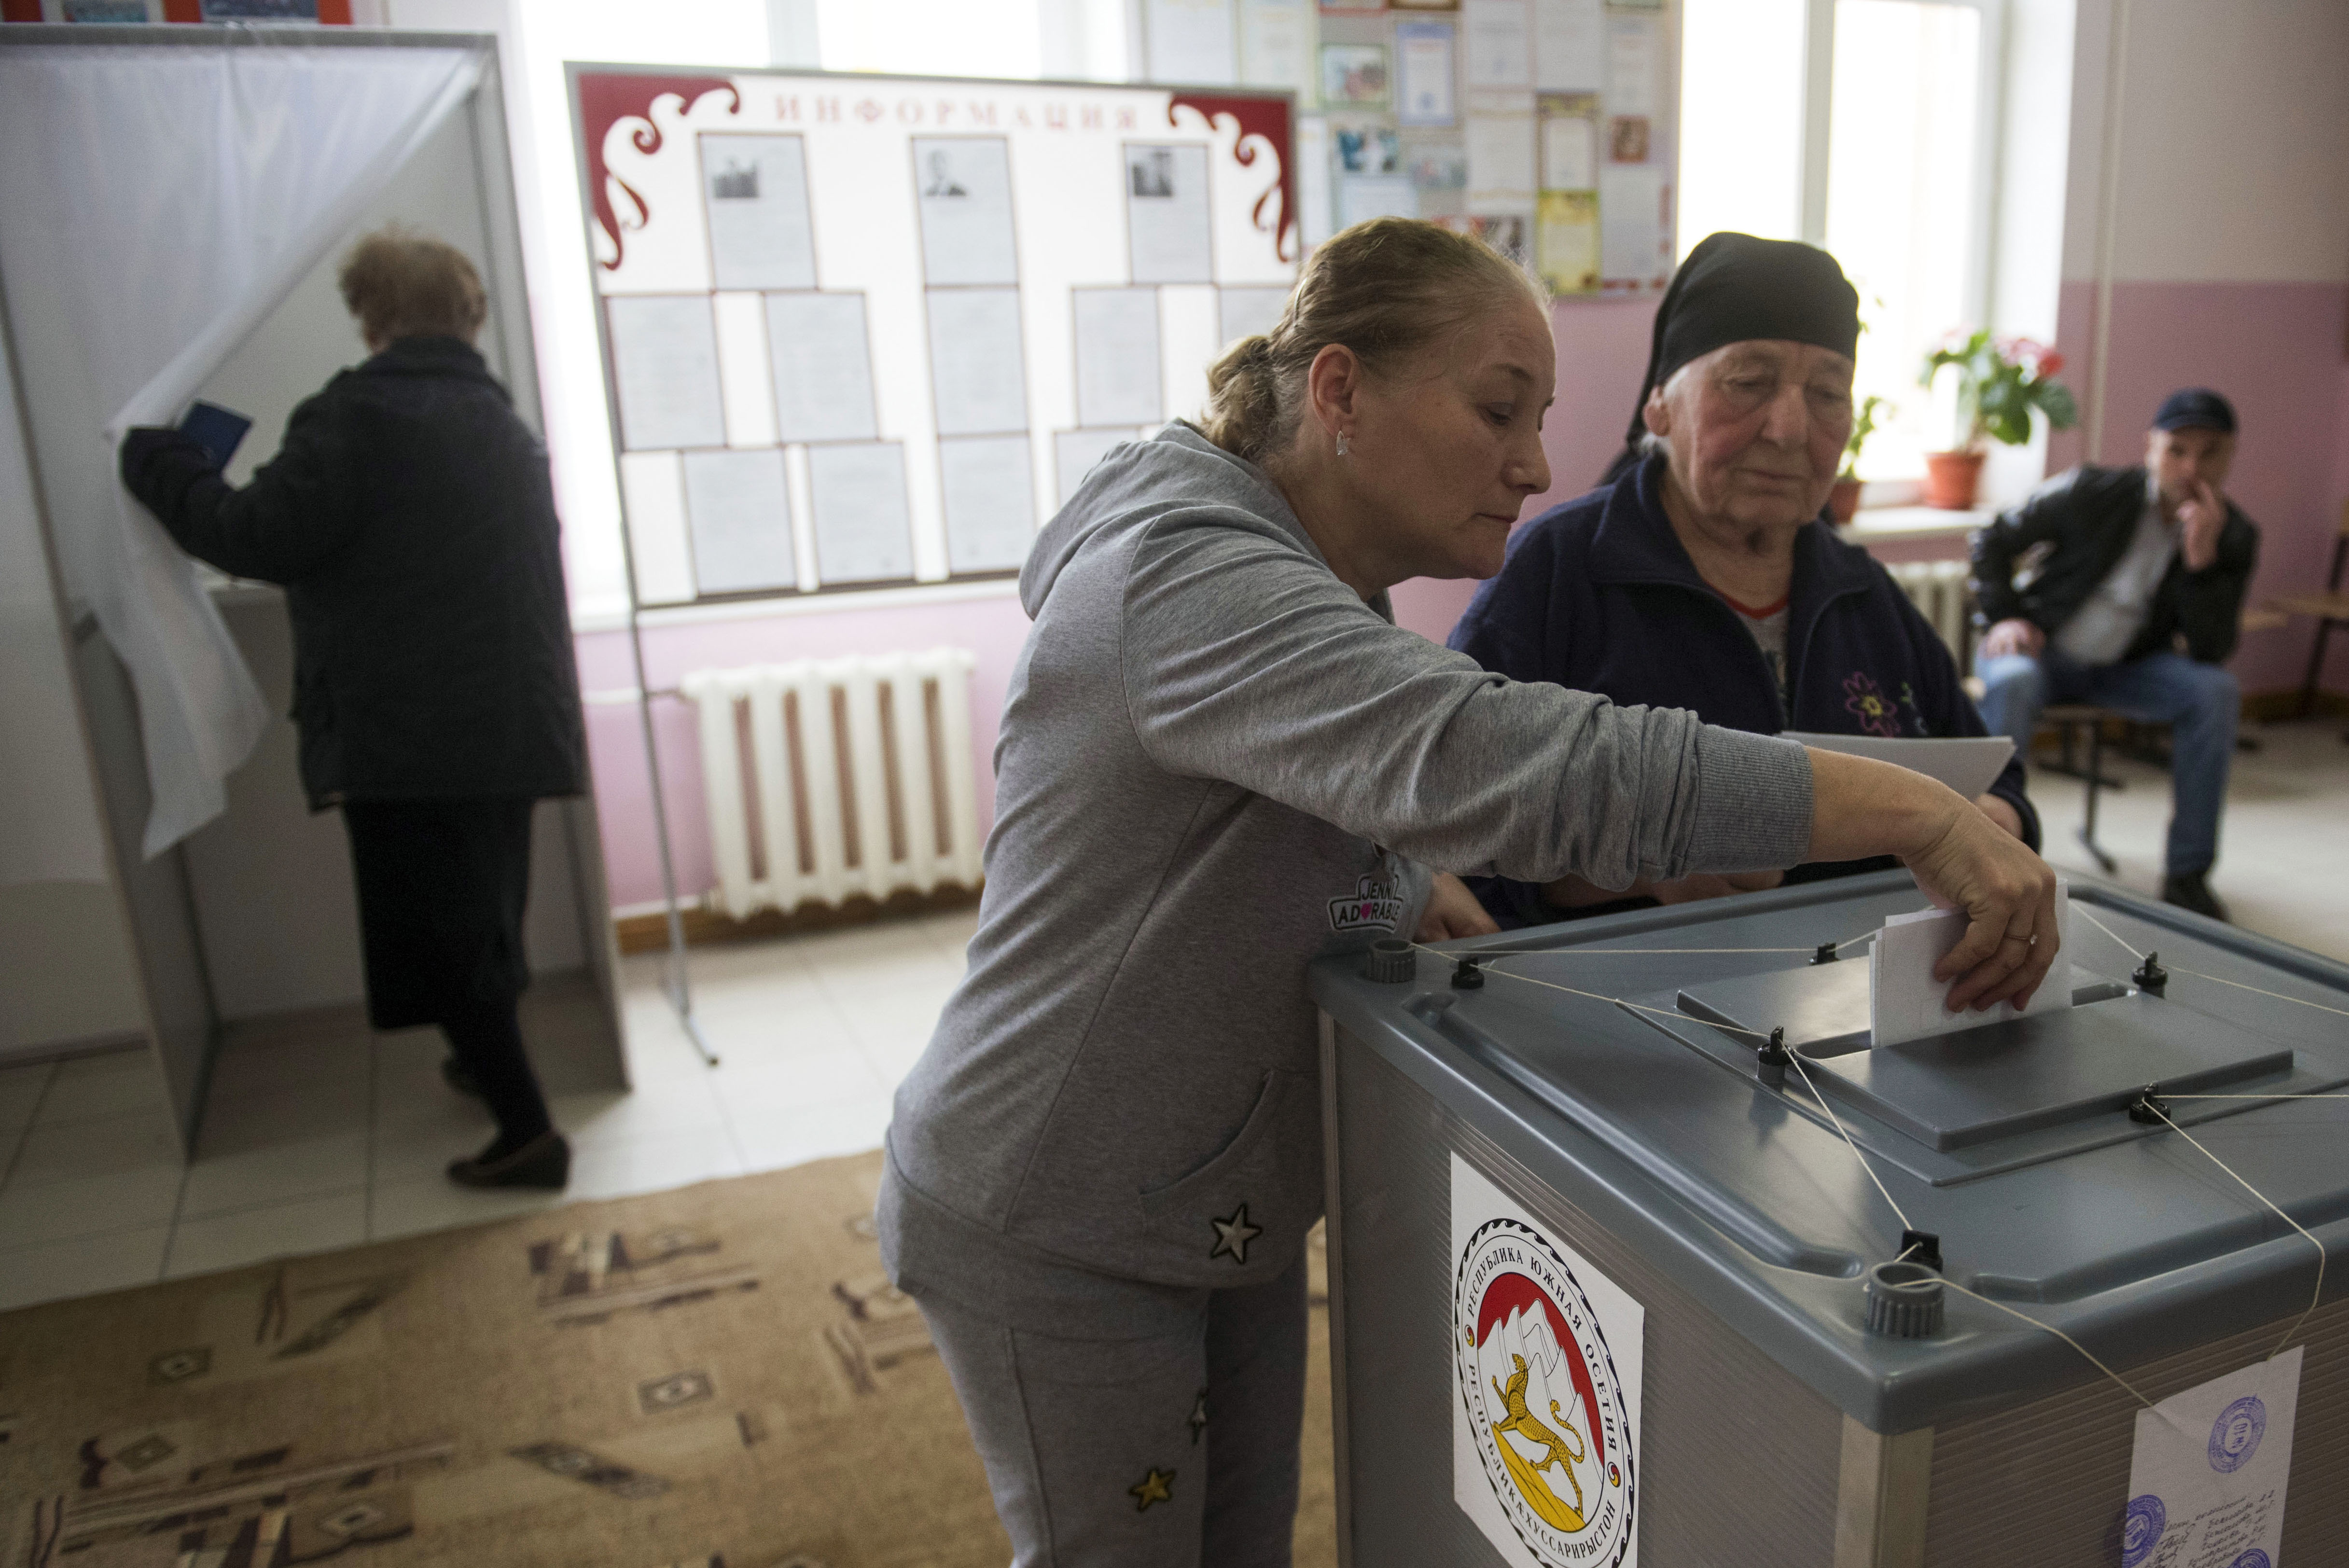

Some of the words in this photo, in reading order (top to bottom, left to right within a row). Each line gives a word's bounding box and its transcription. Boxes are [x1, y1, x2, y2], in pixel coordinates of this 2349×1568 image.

[774, 95, 1137, 130] ИНФОРМАЦИЯ
[1467, 1247, 1524, 1317] РЕСПУБЛИКА
[1530, 1256, 1582, 1331] ЮЖНАЯ
[1585, 1344, 1617, 1452] ОСЕТИЯ
